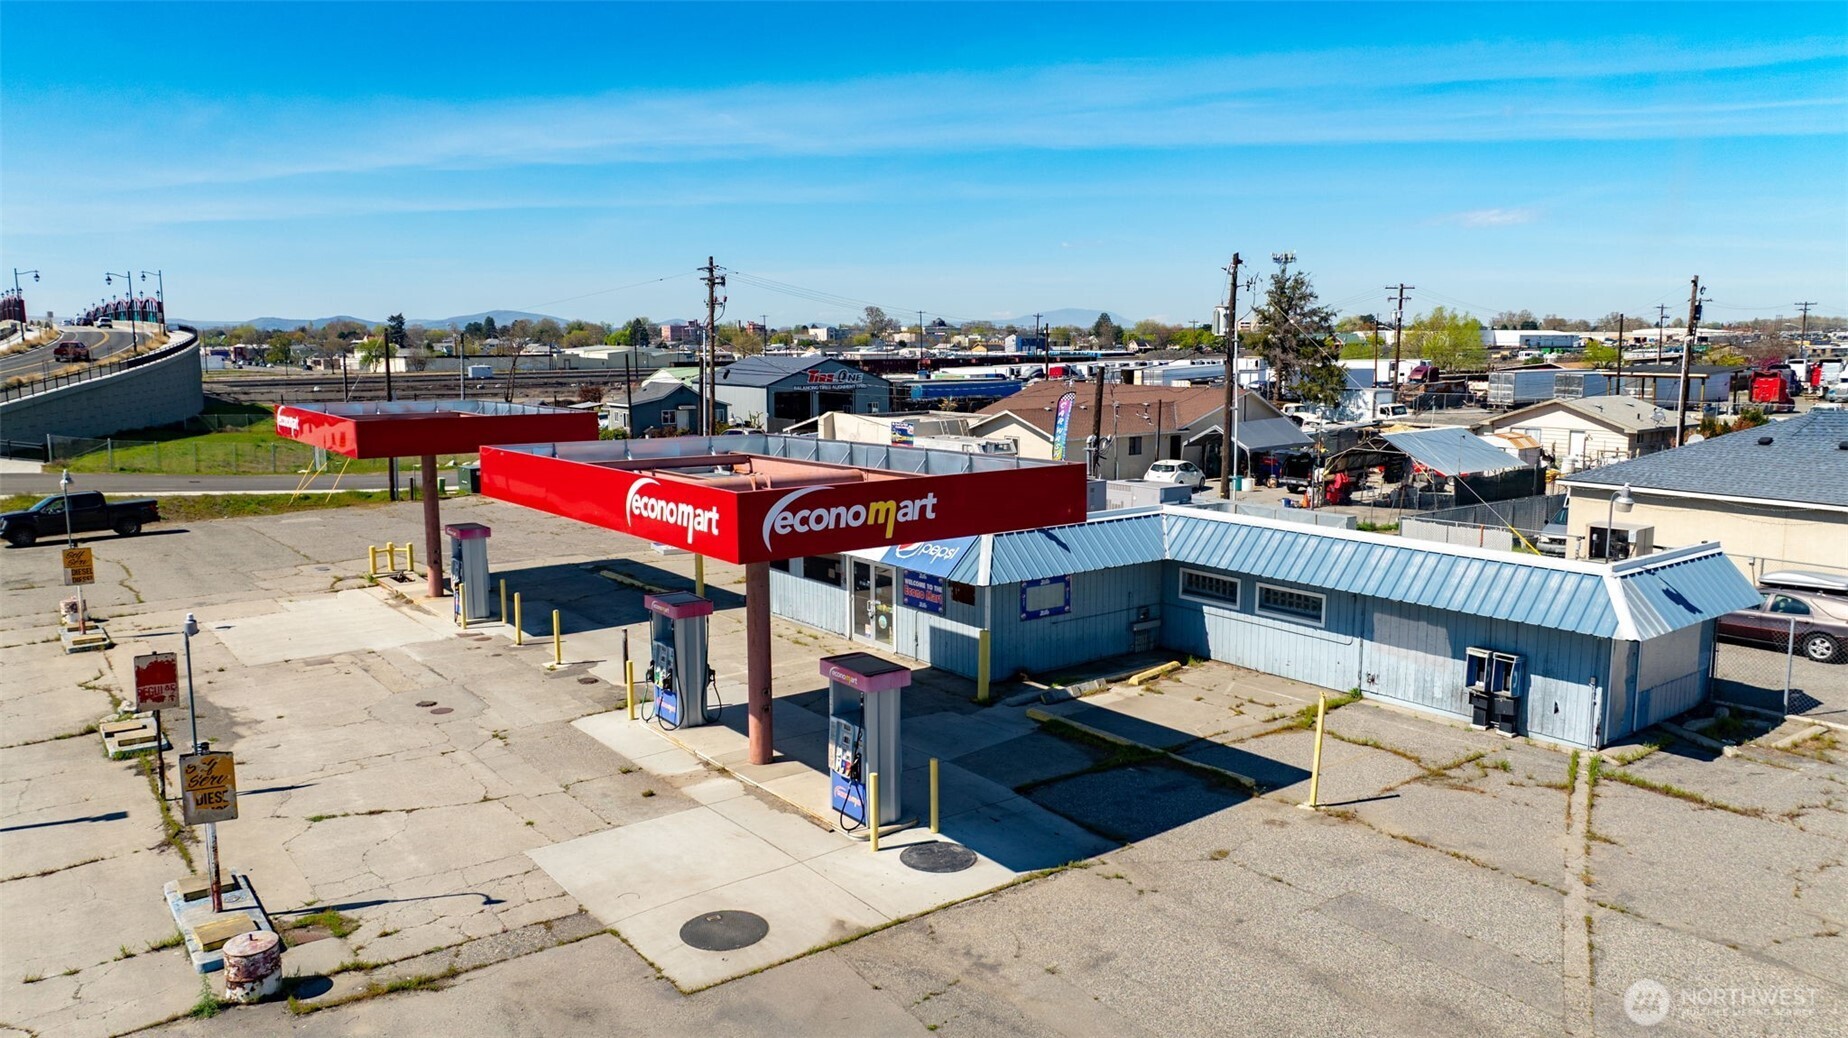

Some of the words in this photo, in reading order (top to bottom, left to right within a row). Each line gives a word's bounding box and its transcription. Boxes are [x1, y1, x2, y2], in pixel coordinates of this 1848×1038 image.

[838, 369, 863, 383] ONE
[1057, 402, 1067, 425] CAR
[1053, 427, 1063, 458] WASH
[632, 494, 719, 544] economart
[774, 492, 937, 539] economart
[918, 542, 959, 564] pepsi
[71, 568, 93, 576] DIESEL
[904, 578, 926, 589] WELCOME
[934, 585, 943, 593] THE
